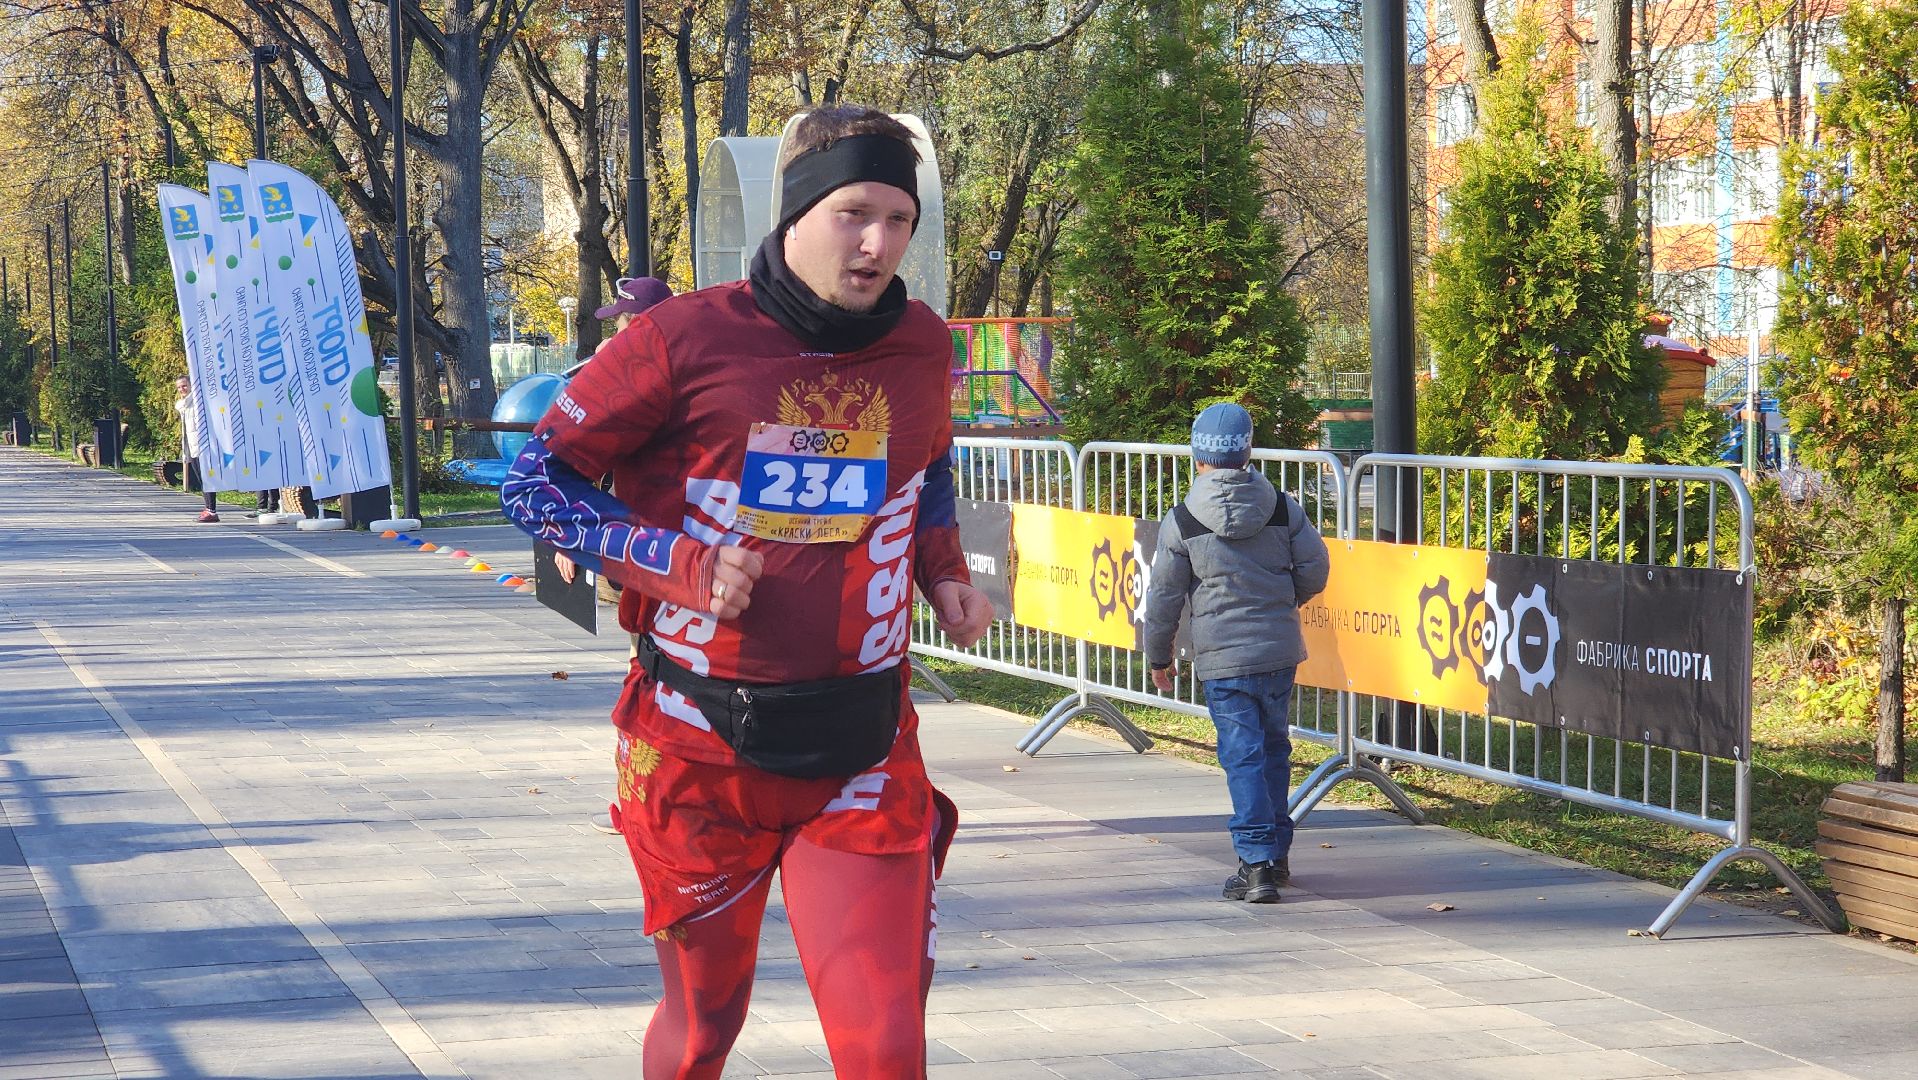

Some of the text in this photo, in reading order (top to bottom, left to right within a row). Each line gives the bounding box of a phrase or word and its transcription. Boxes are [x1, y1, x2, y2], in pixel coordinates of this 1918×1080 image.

[758, 460, 869, 508] 234
[770, 526, 811, 539] «КРАСКИ
[816, 526, 848, 539] ЛЕСА»
[970, 553, 996, 576] СПОРТА
[1050, 565, 1079, 588] СПОРТА
[1304, 604, 1401, 638] ФАБРИКА СПОРТА
[1576, 639, 1713, 682] ФАБРИКА СПОРТА
[694, 885, 729, 904] TEAM
